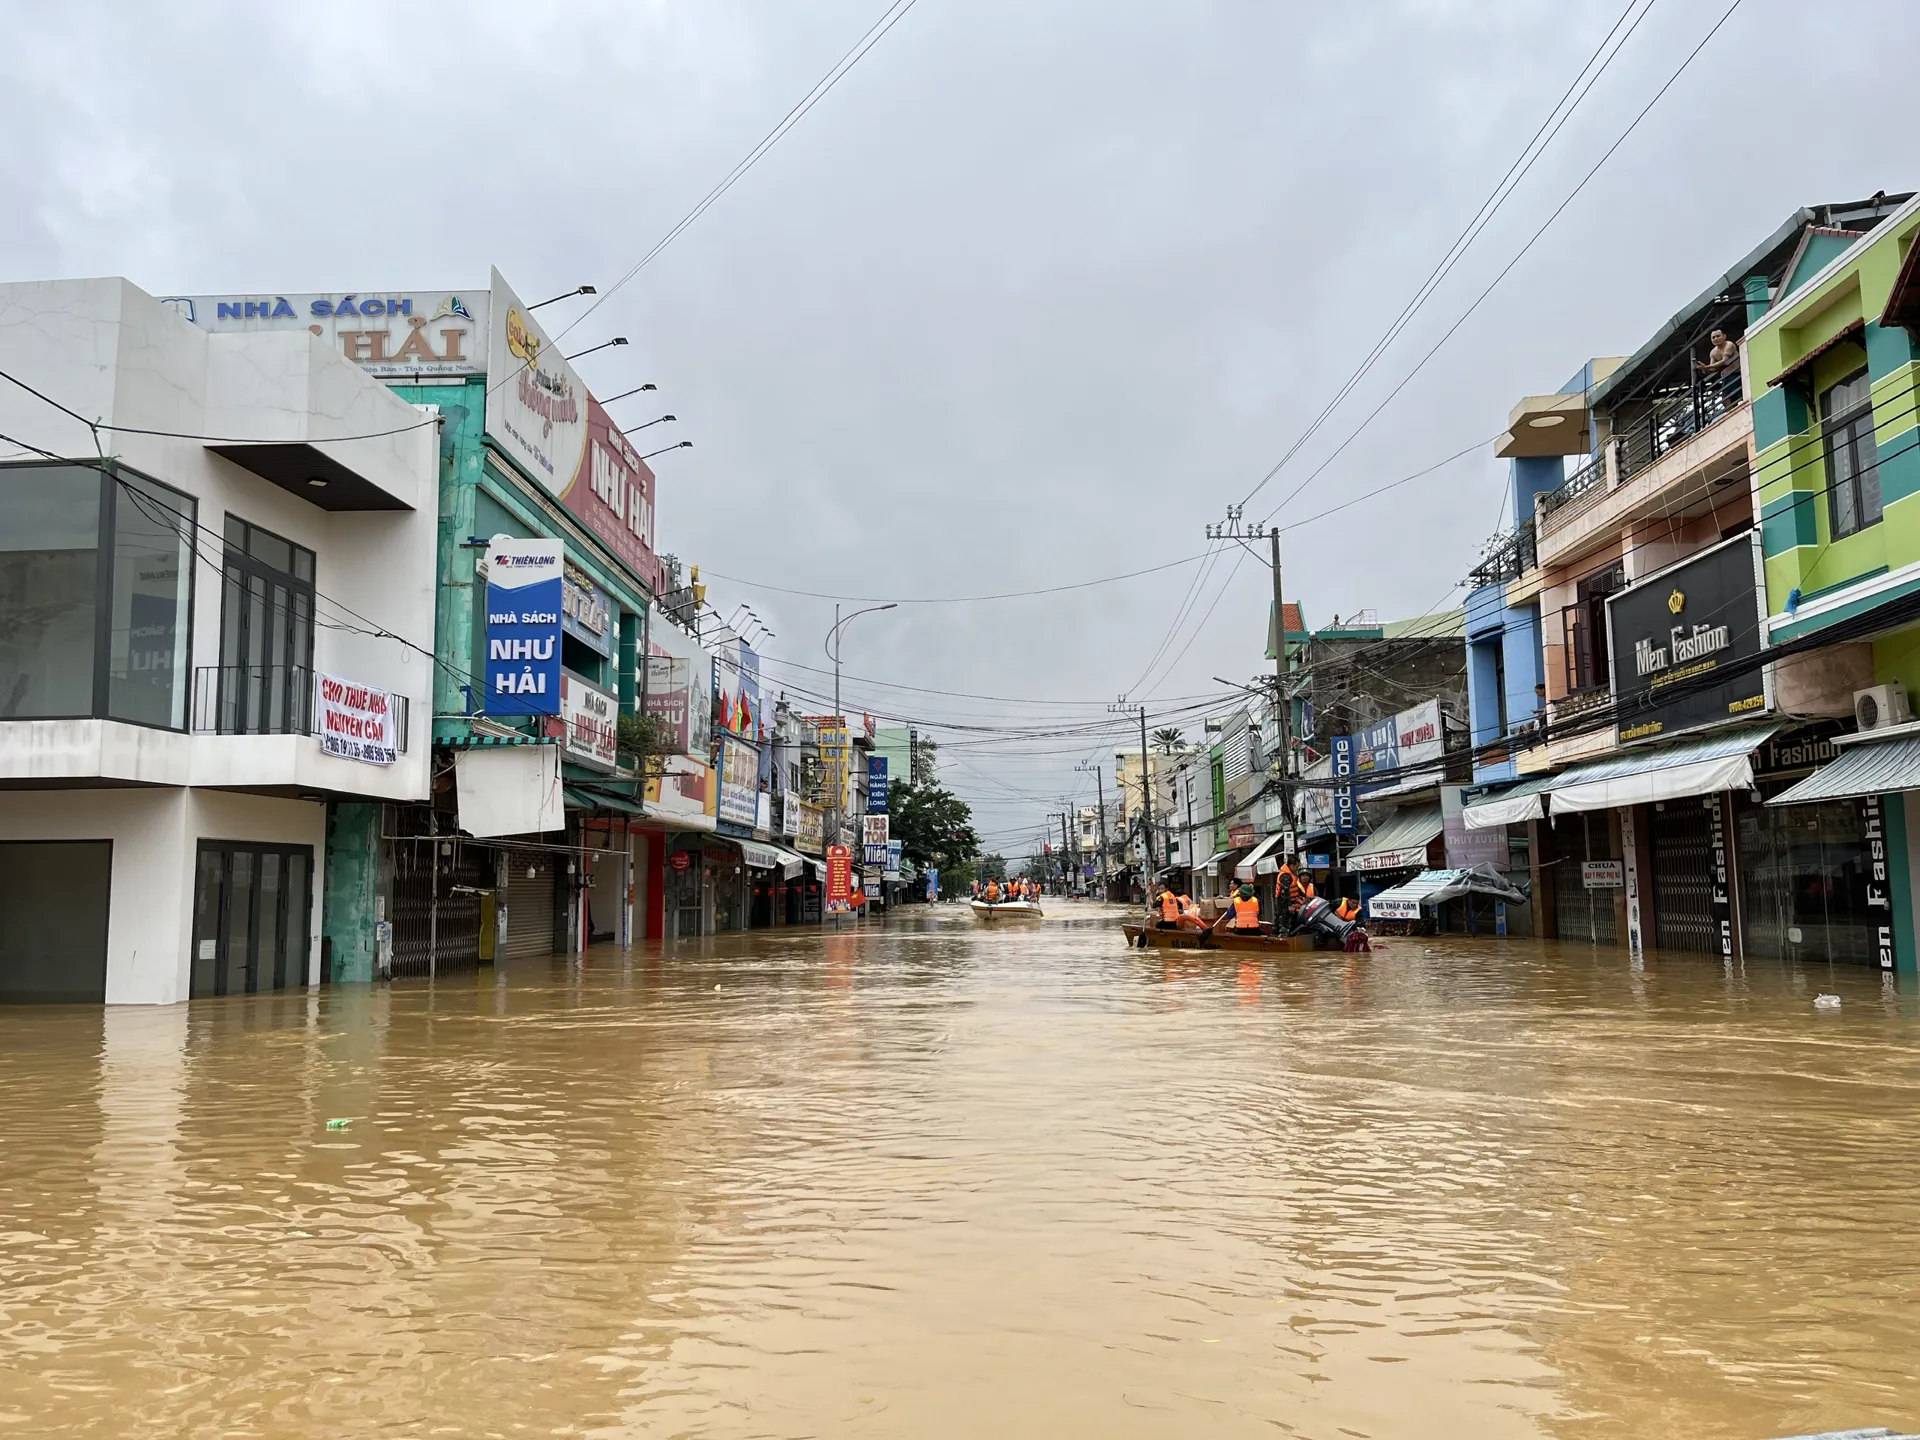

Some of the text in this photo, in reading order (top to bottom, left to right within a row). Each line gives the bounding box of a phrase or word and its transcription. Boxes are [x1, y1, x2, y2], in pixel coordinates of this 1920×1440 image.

[217, 295, 413, 319] NHÀ SÁCH
[338, 316, 467, 363] HẢI
[607, 426, 639, 475] NHÀ SÁCH
[589, 437, 627, 520] NHƯ
[627, 479, 653, 551] HẢI
[489, 610, 557, 624] NHÀ SÁCH
[578, 593, 605, 637] HẢI
[490, 635, 556, 661] NHƯ
[1635, 623, 1730, 676] Men Fashion
[322, 679, 388, 716] CHO THUÊ NHÀ
[495, 665, 547, 694] HẢI
[326, 710, 385, 743] NGUYÊN CĂN
[575, 712, 599, 745] NHƯ
[600, 719, 617, 752] HẢI
[1335, 740, 1353, 829] mobone
[865, 831, 887, 844] TON
[866, 817, 887, 831] VES
[1862, 795, 1893, 968] en Fashio
[1721, 920, 1732, 955] en
